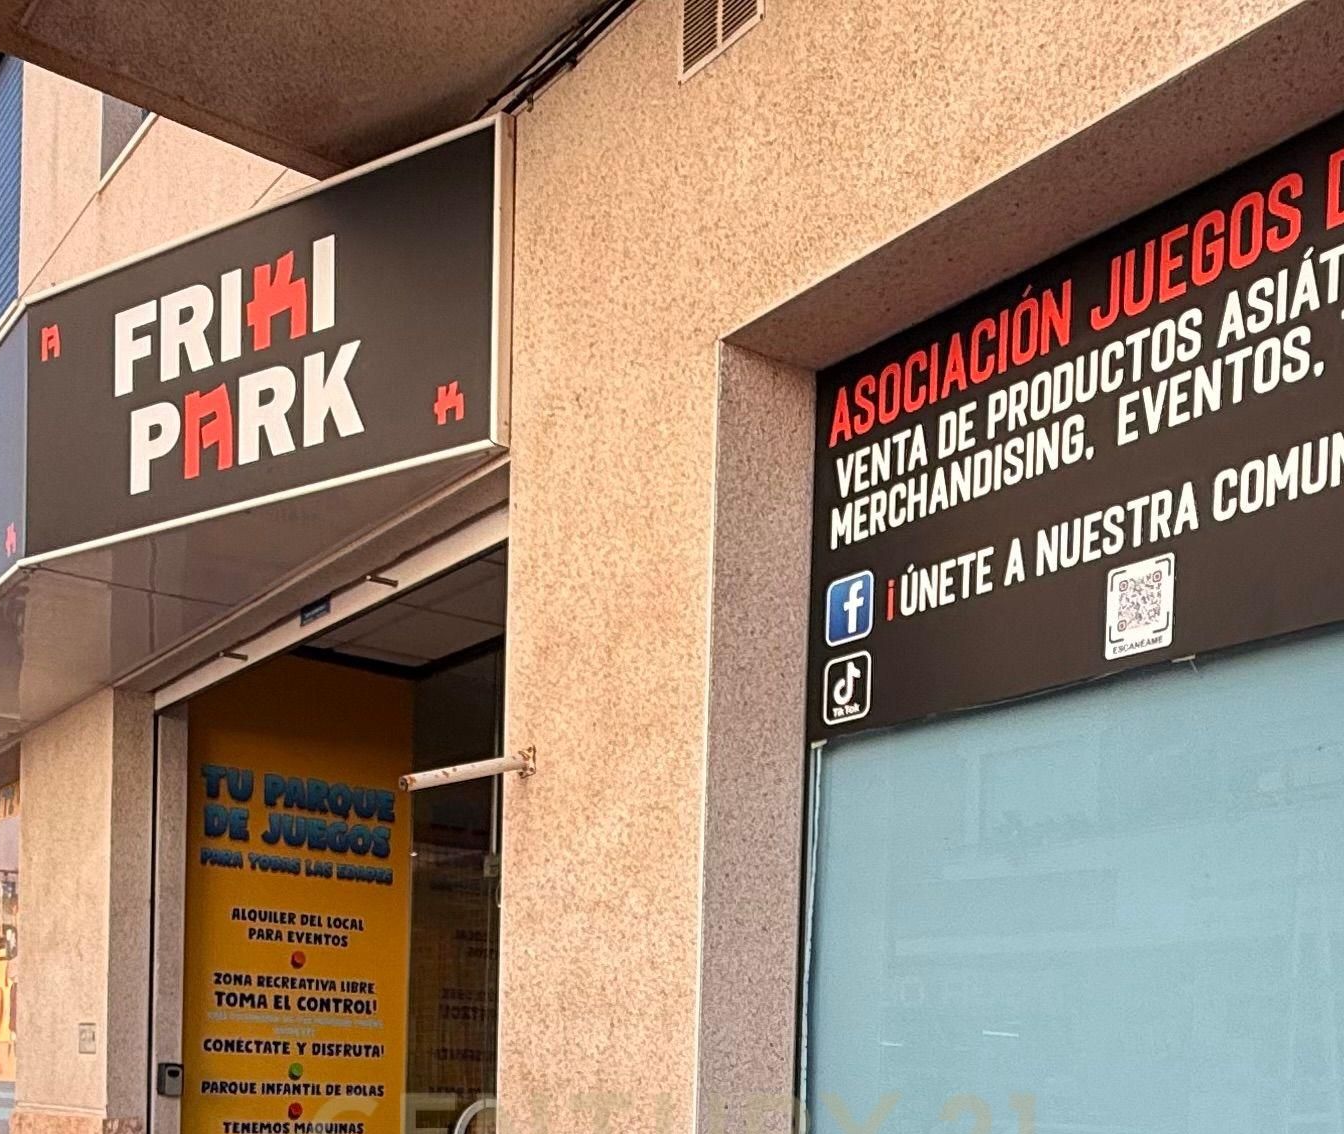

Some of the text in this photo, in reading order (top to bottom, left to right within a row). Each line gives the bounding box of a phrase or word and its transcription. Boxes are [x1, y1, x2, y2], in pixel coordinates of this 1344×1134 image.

[114, 234, 336, 398] FRIKI
[829, 280, 1072, 447] ASOCIACIÓN
[1090, 172, 1304, 331] JUEGOS
[130, 340, 365, 495] PARK
[836, 422, 928, 498] VENTA
[938, 401, 976, 460] DE
[987, 308, 1203, 440] PRODUCTOS
[1004, 538, 1025, 585] A
[1036, 481, 1199, 579] NUESTRA
[201, 765, 396, 822] TU PARQUE
[204, 804, 390, 859] DE JUEGOS
[201, 848, 244, 869] PARA
[306, 859, 333, 878] LAS
[232, 908, 365, 931] ALQUILER DEL LOCAL
[248, 928, 348, 948] PARA EVENTOS
[214, 972, 375, 995] ZONA RECREATIVA LIBRE
[214, 991, 377, 1015] TOMA EL CONTROL!
[203, 1037, 385, 1058] CONÉCTATE Y DISFRUTA!
[201, 1081, 385, 1097] PARQUE INFANTIL DE BOLAS
[223, 1121, 290, 1134] TENEMOS
